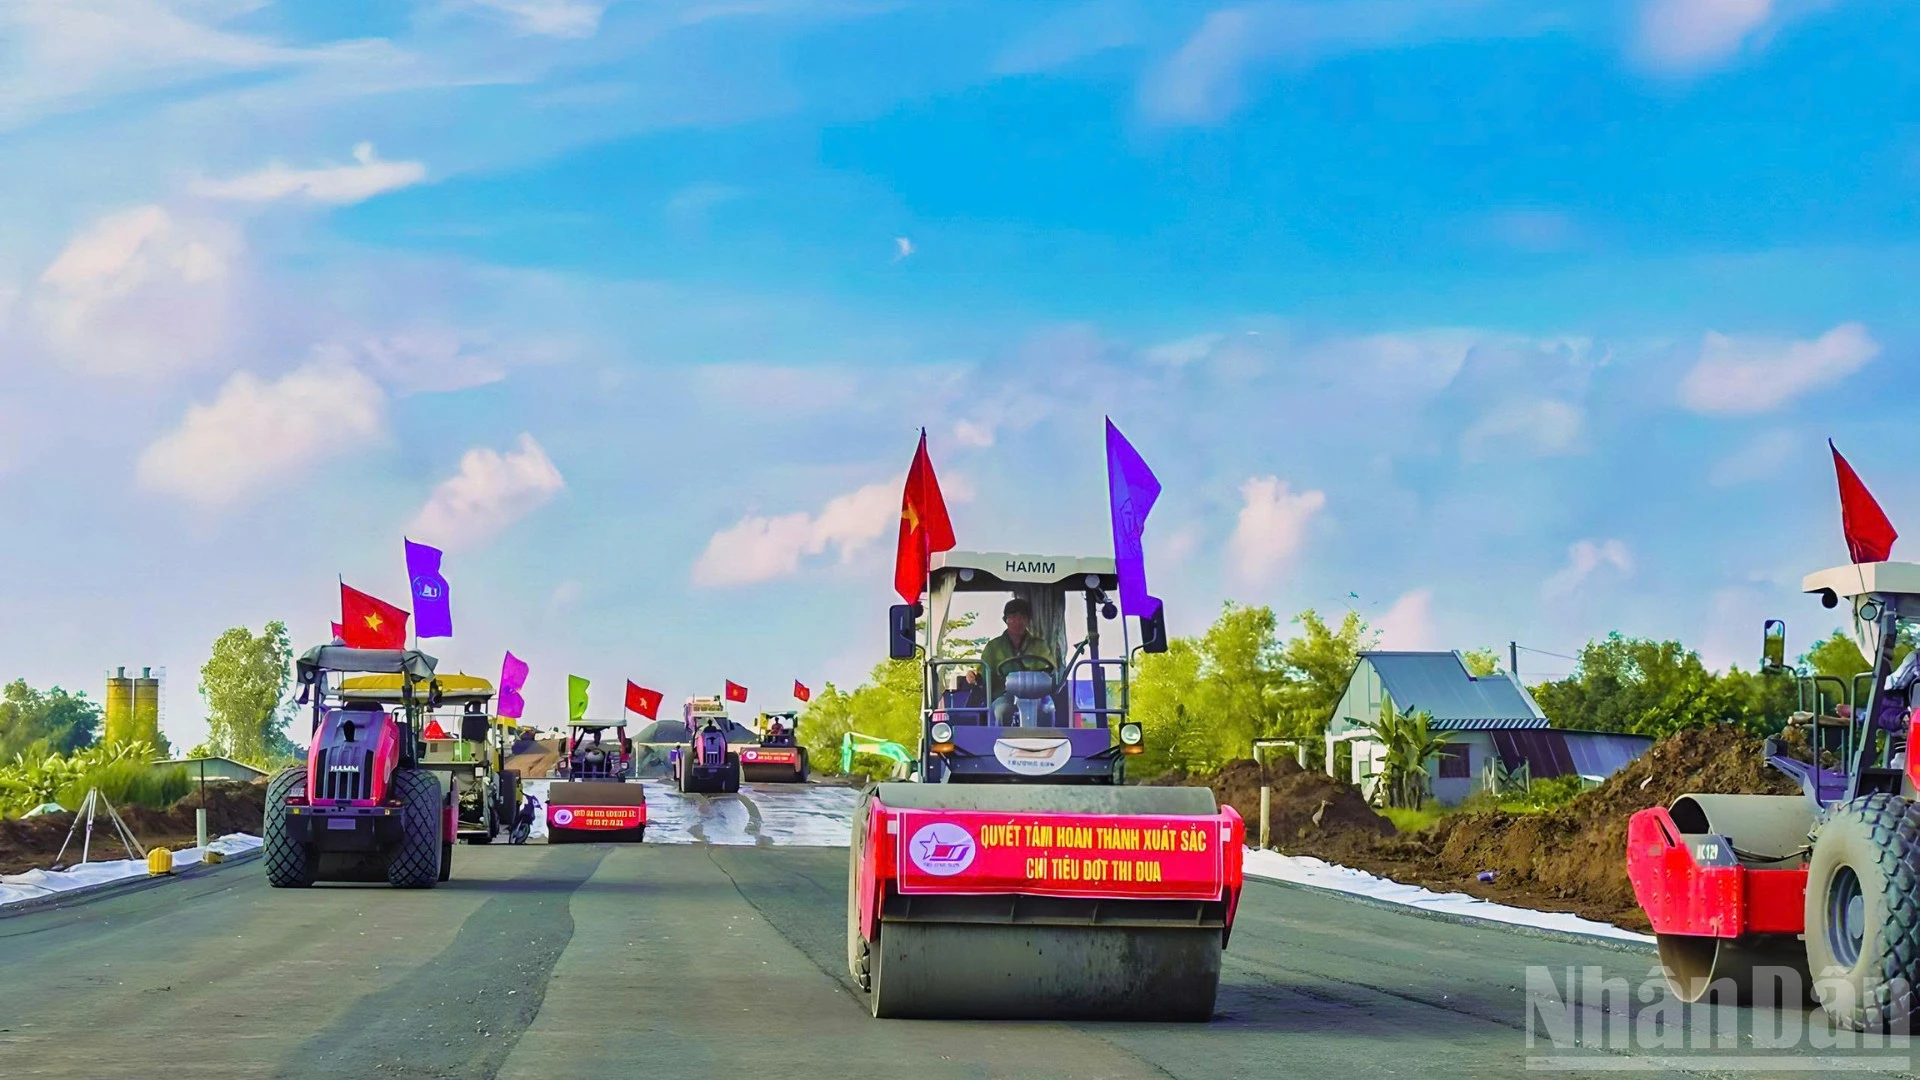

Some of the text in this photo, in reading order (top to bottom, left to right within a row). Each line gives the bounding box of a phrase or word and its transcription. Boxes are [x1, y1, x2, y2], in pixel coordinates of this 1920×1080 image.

[1006, 561, 1055, 573] HAMM
[980, 818, 1207, 852] QUYẾT TÂM HOÀN THÀNH XUẤT SẮC
[1026, 851, 1161, 885] CHỈ TIÊU ĐỢT THI ĐUA
